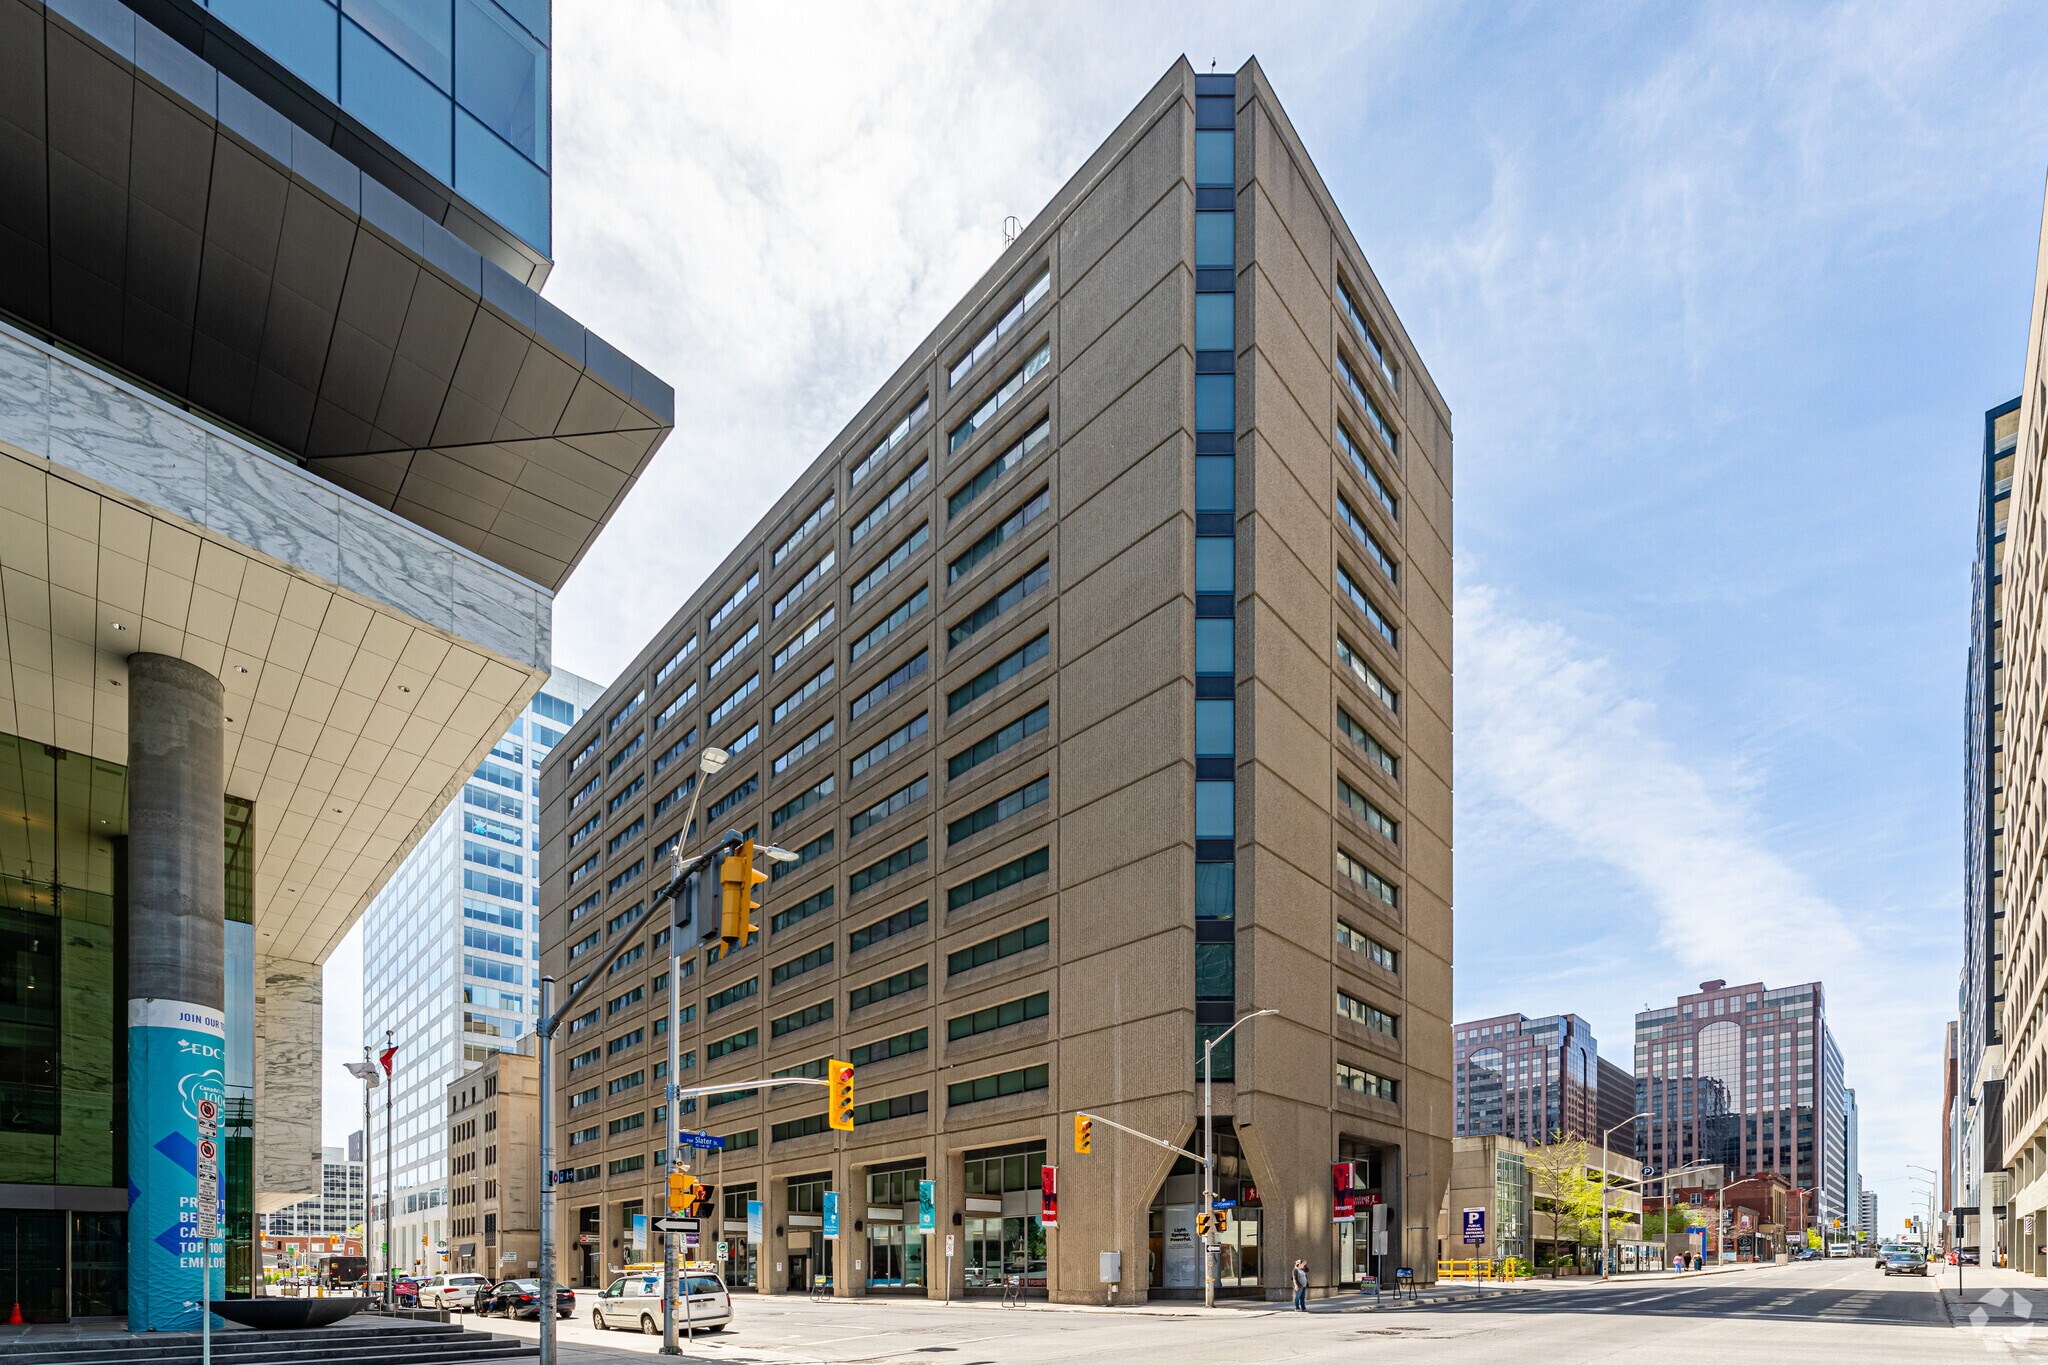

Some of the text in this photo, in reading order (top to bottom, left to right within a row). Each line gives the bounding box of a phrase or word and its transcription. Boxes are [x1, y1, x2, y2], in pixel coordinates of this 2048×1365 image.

[179, 1012, 202, 1024] JOIN
[204, 1017, 220, 1029] OUR
[191, 1043, 221, 1060] EDC
[695, 1136, 712, 1145] Slater
[1469, 1212, 1480, 1224] P
[179, 1242, 223, 1253] TOP 100
